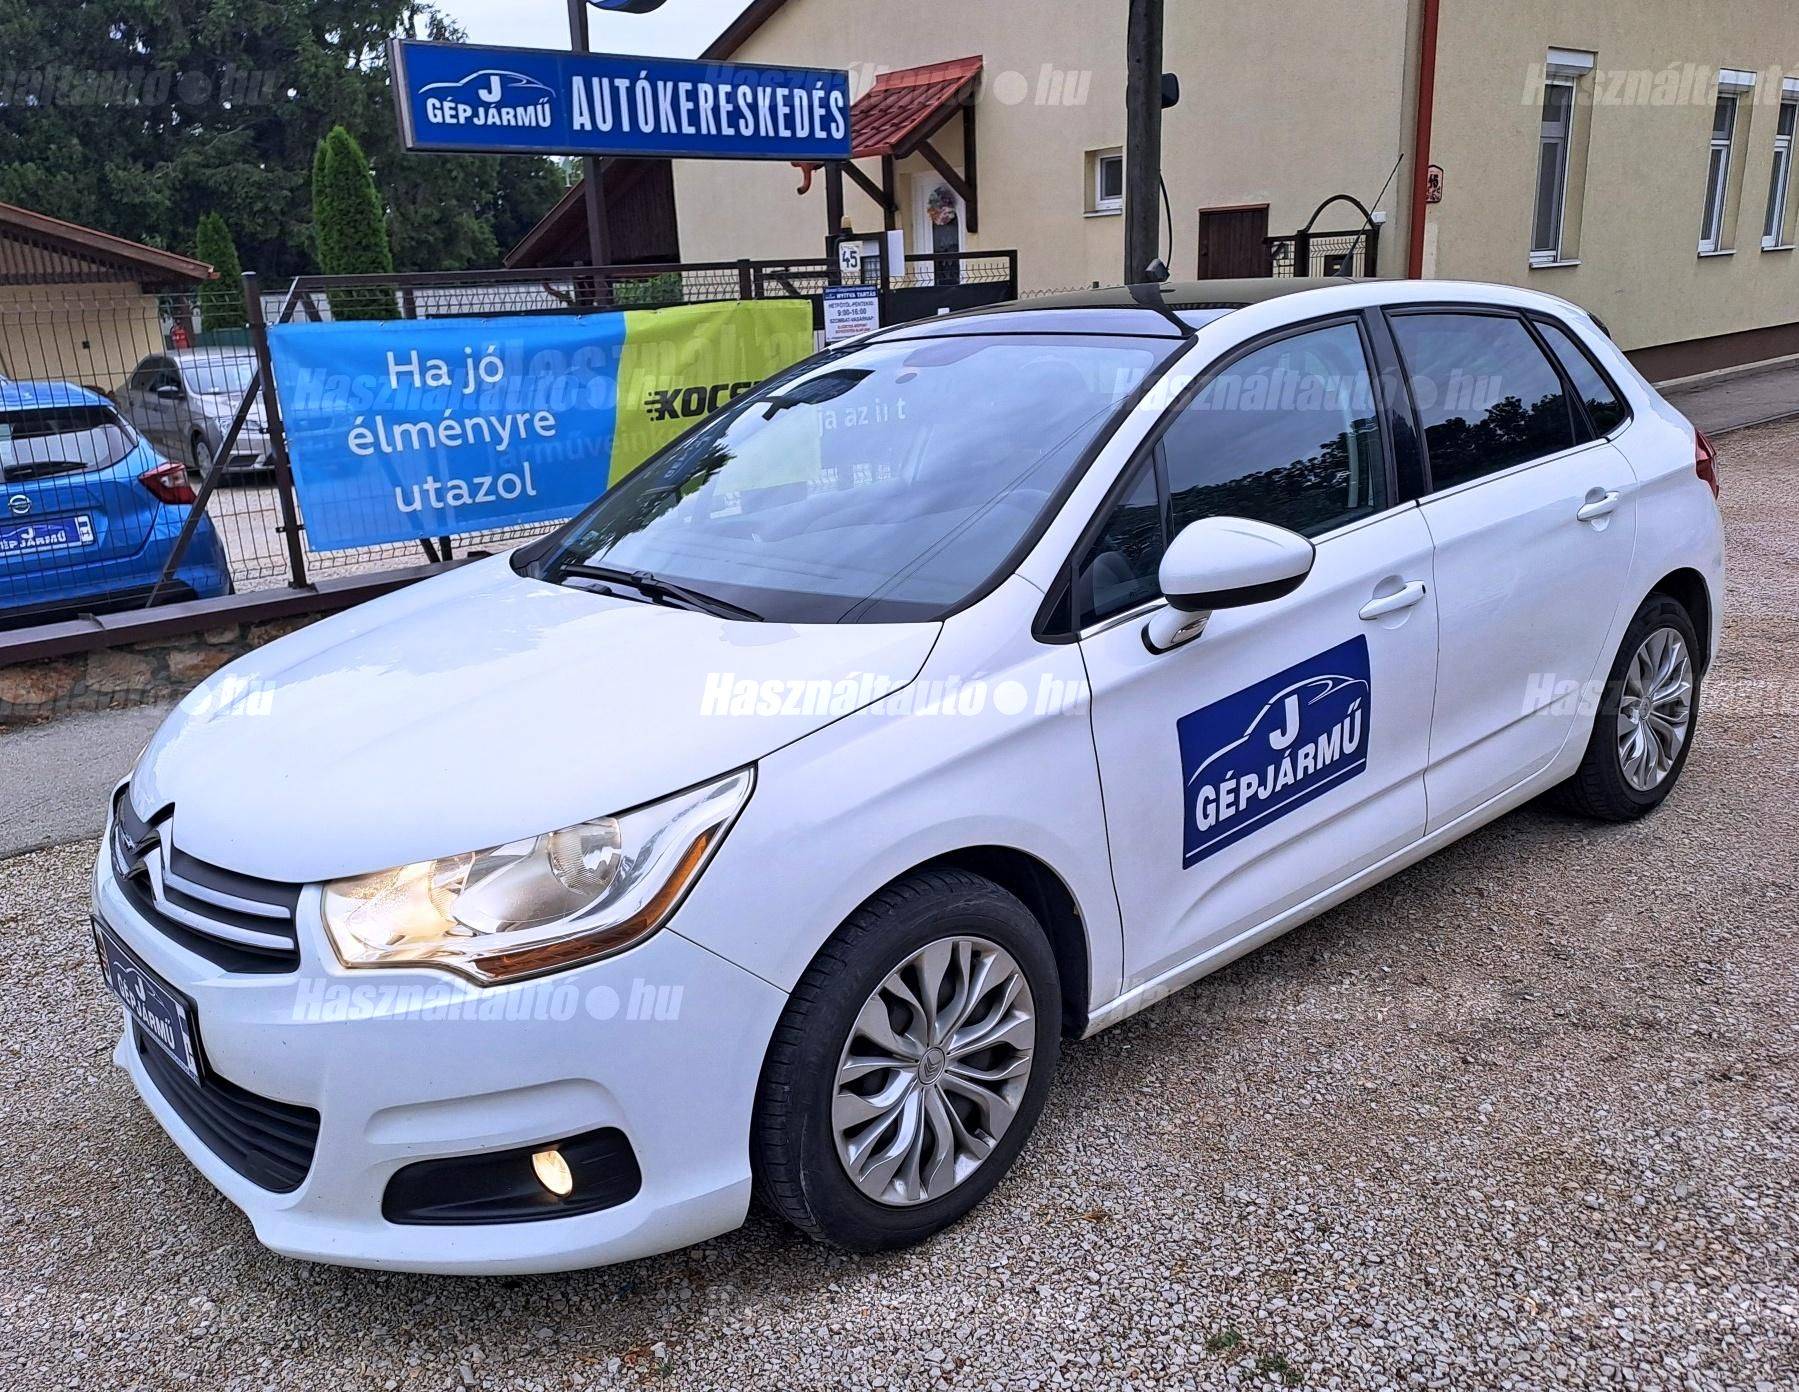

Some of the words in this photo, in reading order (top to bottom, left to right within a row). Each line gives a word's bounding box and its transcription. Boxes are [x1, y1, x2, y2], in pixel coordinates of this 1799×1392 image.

[425, 96, 552, 128] GÉPJÁRMŰ
[477, 74, 502, 102] J
[571, 70, 845, 140] AUTÓKERESKEDÉS
[842, 250, 858, 268] 45
[386, 350, 452, 390] Ha
[463, 344, 504, 394] jó
[347, 406, 557, 456] élményre
[394, 462, 537, 513] utazol
[1268, 693, 1300, 750] J
[1195, 697, 1362, 832] GÉPJÁRMŰ
[134, 975, 146, 1002] J
